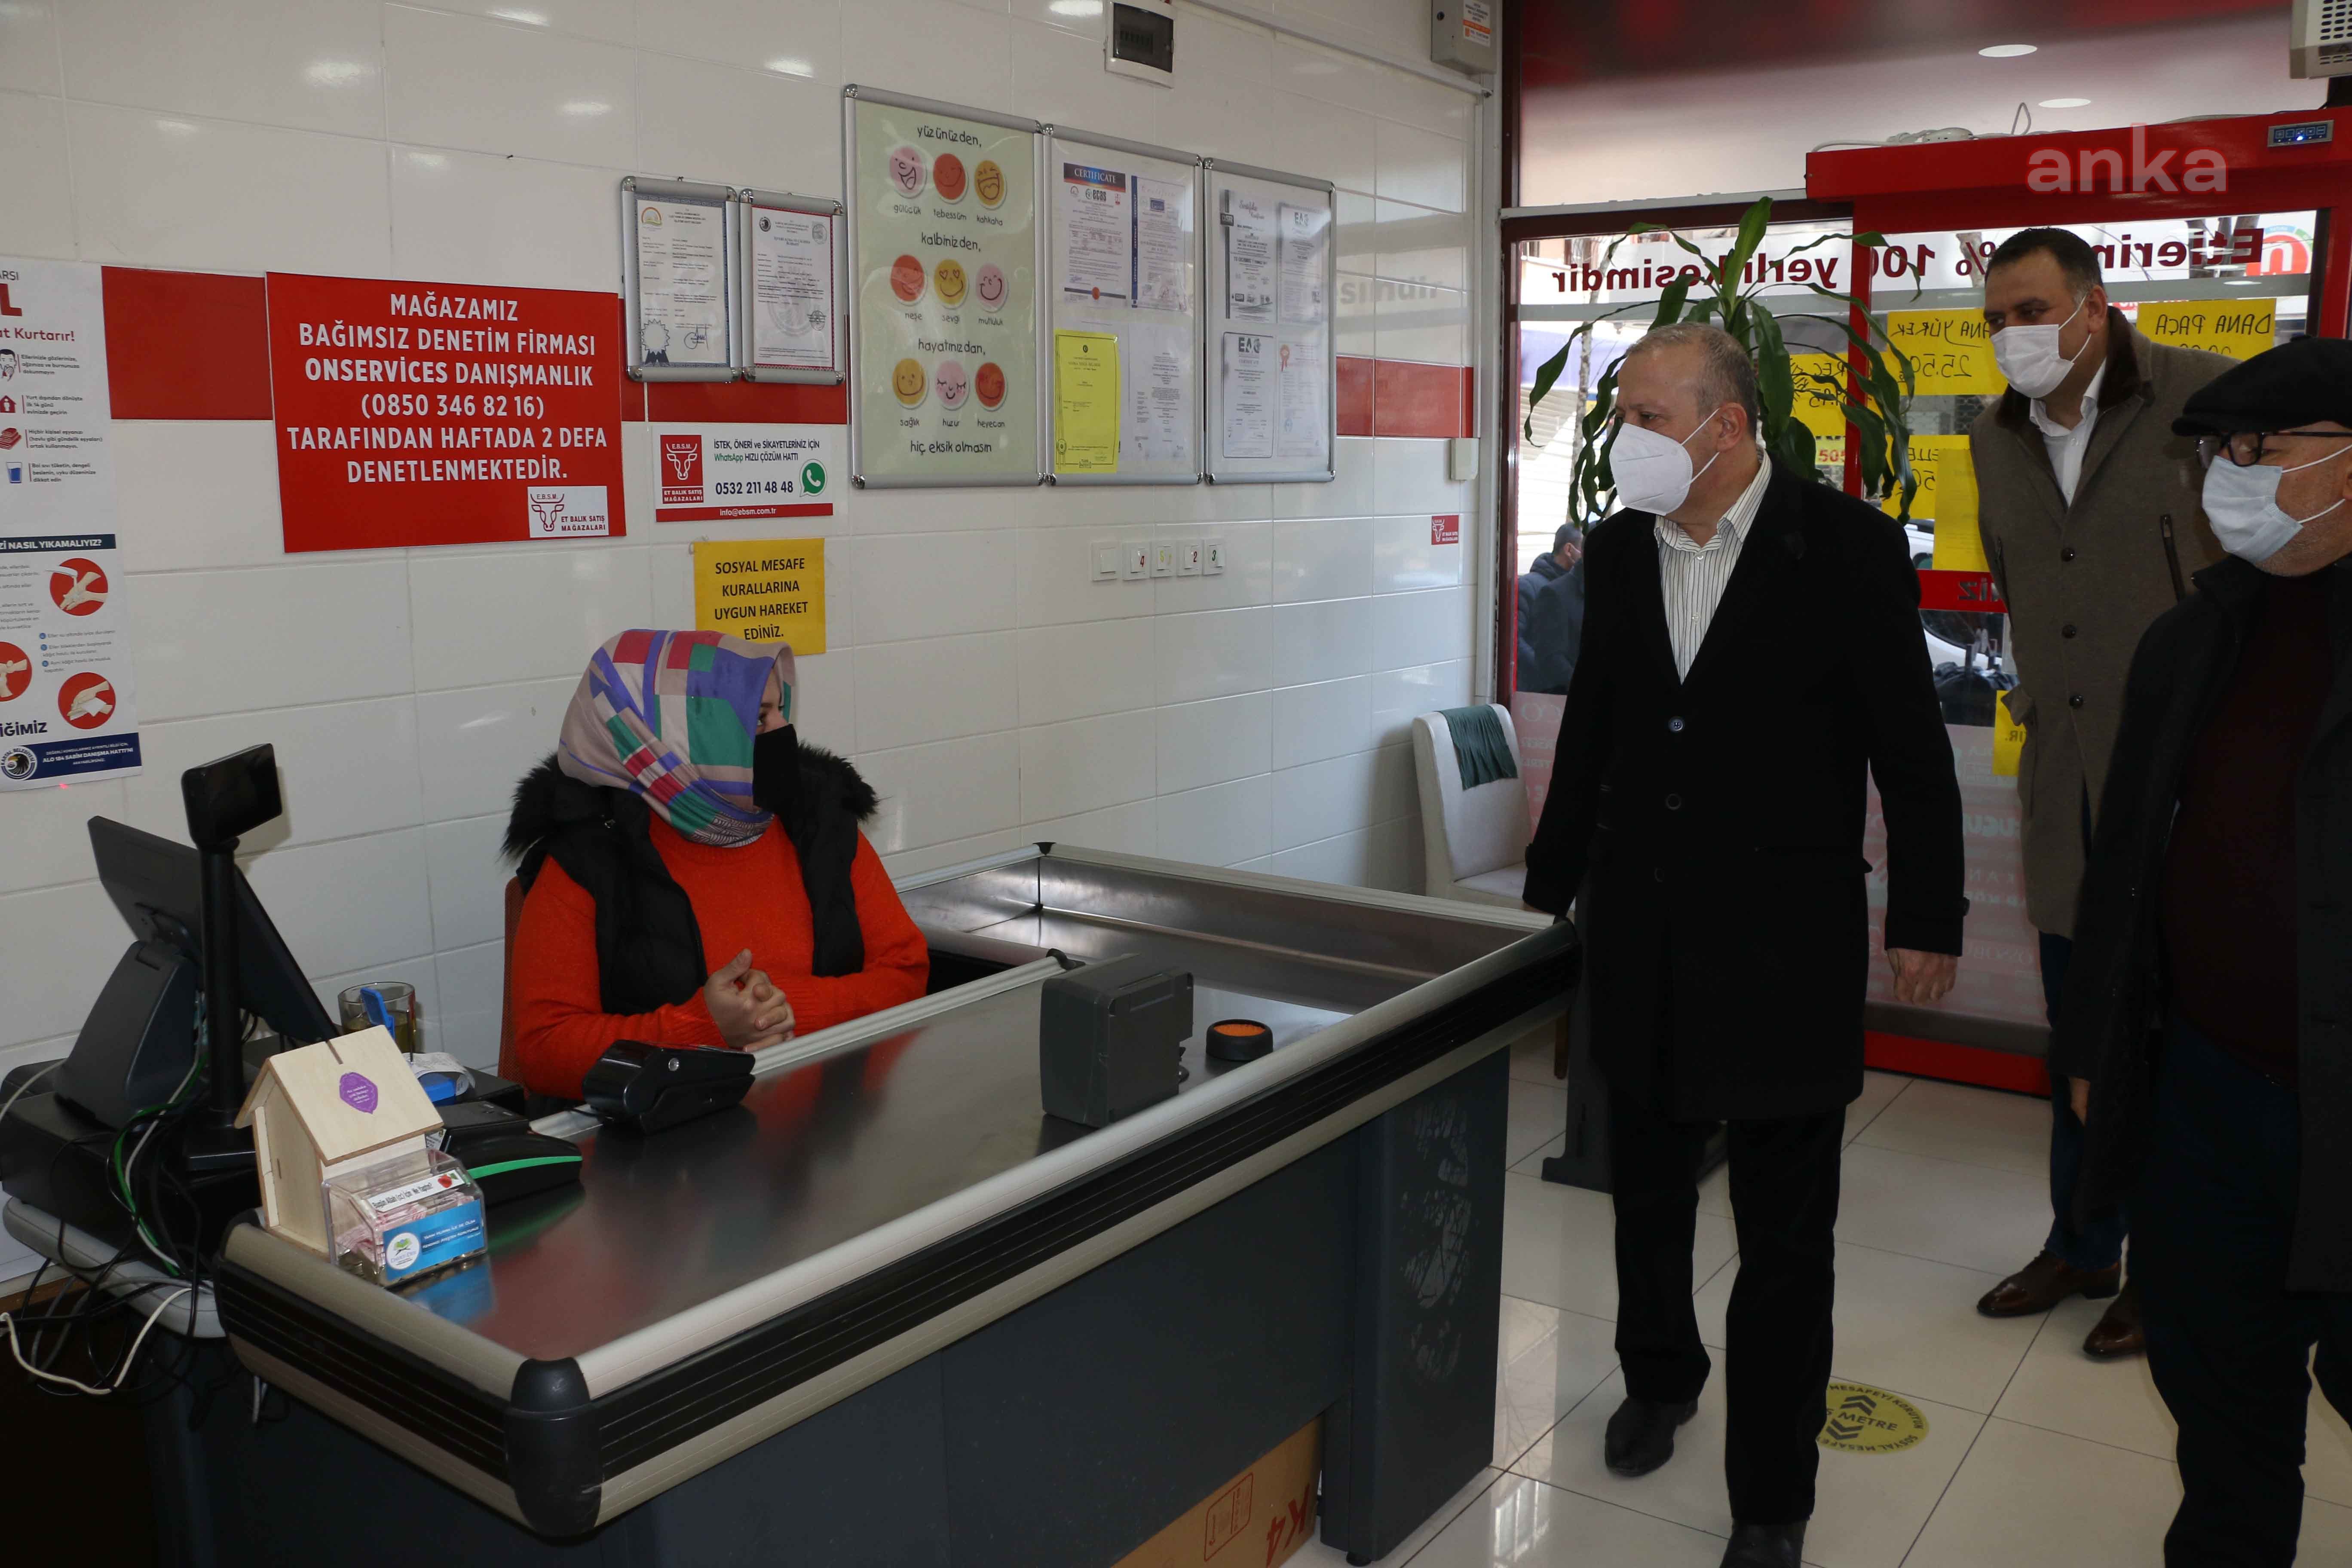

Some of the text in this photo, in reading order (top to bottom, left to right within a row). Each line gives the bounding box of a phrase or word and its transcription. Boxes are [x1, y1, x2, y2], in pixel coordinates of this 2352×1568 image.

[917, 125, 982, 148] yüzünüzden,
[1074, 168, 1116, 184] CERTIFICATE
[894, 204, 921, 215] gülücük
[934, 208, 966, 221] tebessüm
[977, 215, 1003, 226] kahkaha
[921, 232, 981, 252] kalbinizden,
[391, 291, 518, 321] MAĞAZAMIZ
[905, 312, 922, 322] neşe
[942, 314, 960, 325] sevgi
[978, 317, 1004, 326] mutluluk
[15, 328, 75, 342] Kurtarır!
[300, 320, 595, 355] BAĞIMSIZ DENETİM FİRMASI
[918, 338, 986, 355] hayatınızdan,
[305, 357, 594, 388] ONSERVİCES DANIŞMANLIK
[361, 393, 544, 420] (0850 346 82 16)
[900, 417, 920, 428] sağlık
[943, 419, 960, 427] huzur
[977, 419, 1005, 429] heyecan
[287, 427, 607, 450] TARAFINDAN HAFTADA 2 DEFA
[714, 438, 732, 450] İSTEK,
[734, 439, 752, 449] ÖNERİ
[808, 439, 820, 450] İÇİN
[910, 440, 926, 455] hiç
[929, 441, 953, 453] eksik
[714, 452, 799, 463] WhatsApp HIZLI ÇÖZÜM HATTI
[348, 454, 567, 483] DENETLENMEKTEDİR.
[716, 481, 793, 495] 0532 211 48 48
[720, 507, 776, 517] info@ebsm.com.tr
[9, 540, 38, 550] NASIL
[39, 539, 102, 548] YIKAMALIYIZ?
[1193, 551, 1197, 562] 2
[1212, 550, 1216, 561] 3
[715, 558, 805, 574] SOSYAL MESAFE
[722, 580, 800, 597] KURALLARINA
[714, 601, 808, 620] UYGUN HAREKET
[744, 624, 784, 640] EDİNİZ.
[1838, 1412, 1898, 1431] METRE
